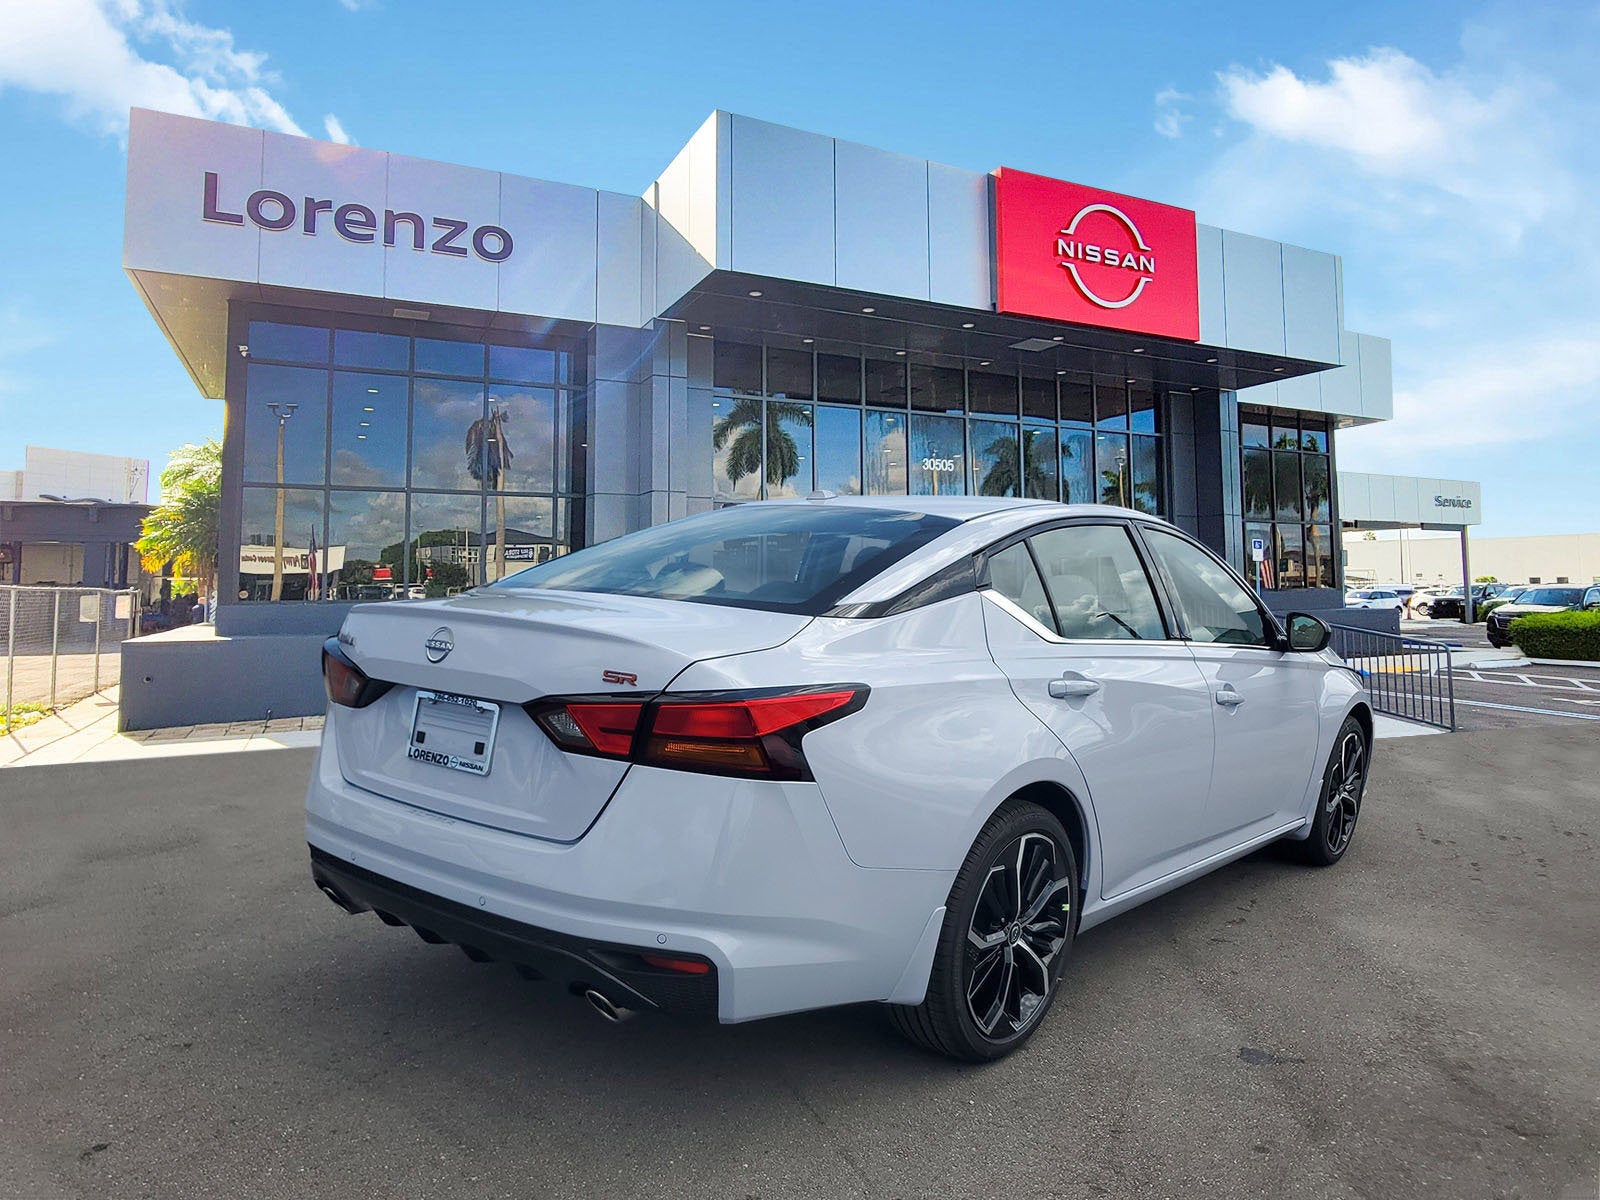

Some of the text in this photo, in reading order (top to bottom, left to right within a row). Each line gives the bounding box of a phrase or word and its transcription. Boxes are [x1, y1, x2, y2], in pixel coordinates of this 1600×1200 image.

[203, 171, 514, 262] Lorenzo
[1057, 238, 1155, 273] NISSAN
[922, 458, 954, 471] 30505
[1434, 495, 1472, 508] Service
[602, 669, 637, 686] SR
[408, 747, 484, 772] LORENZO NISSAN
